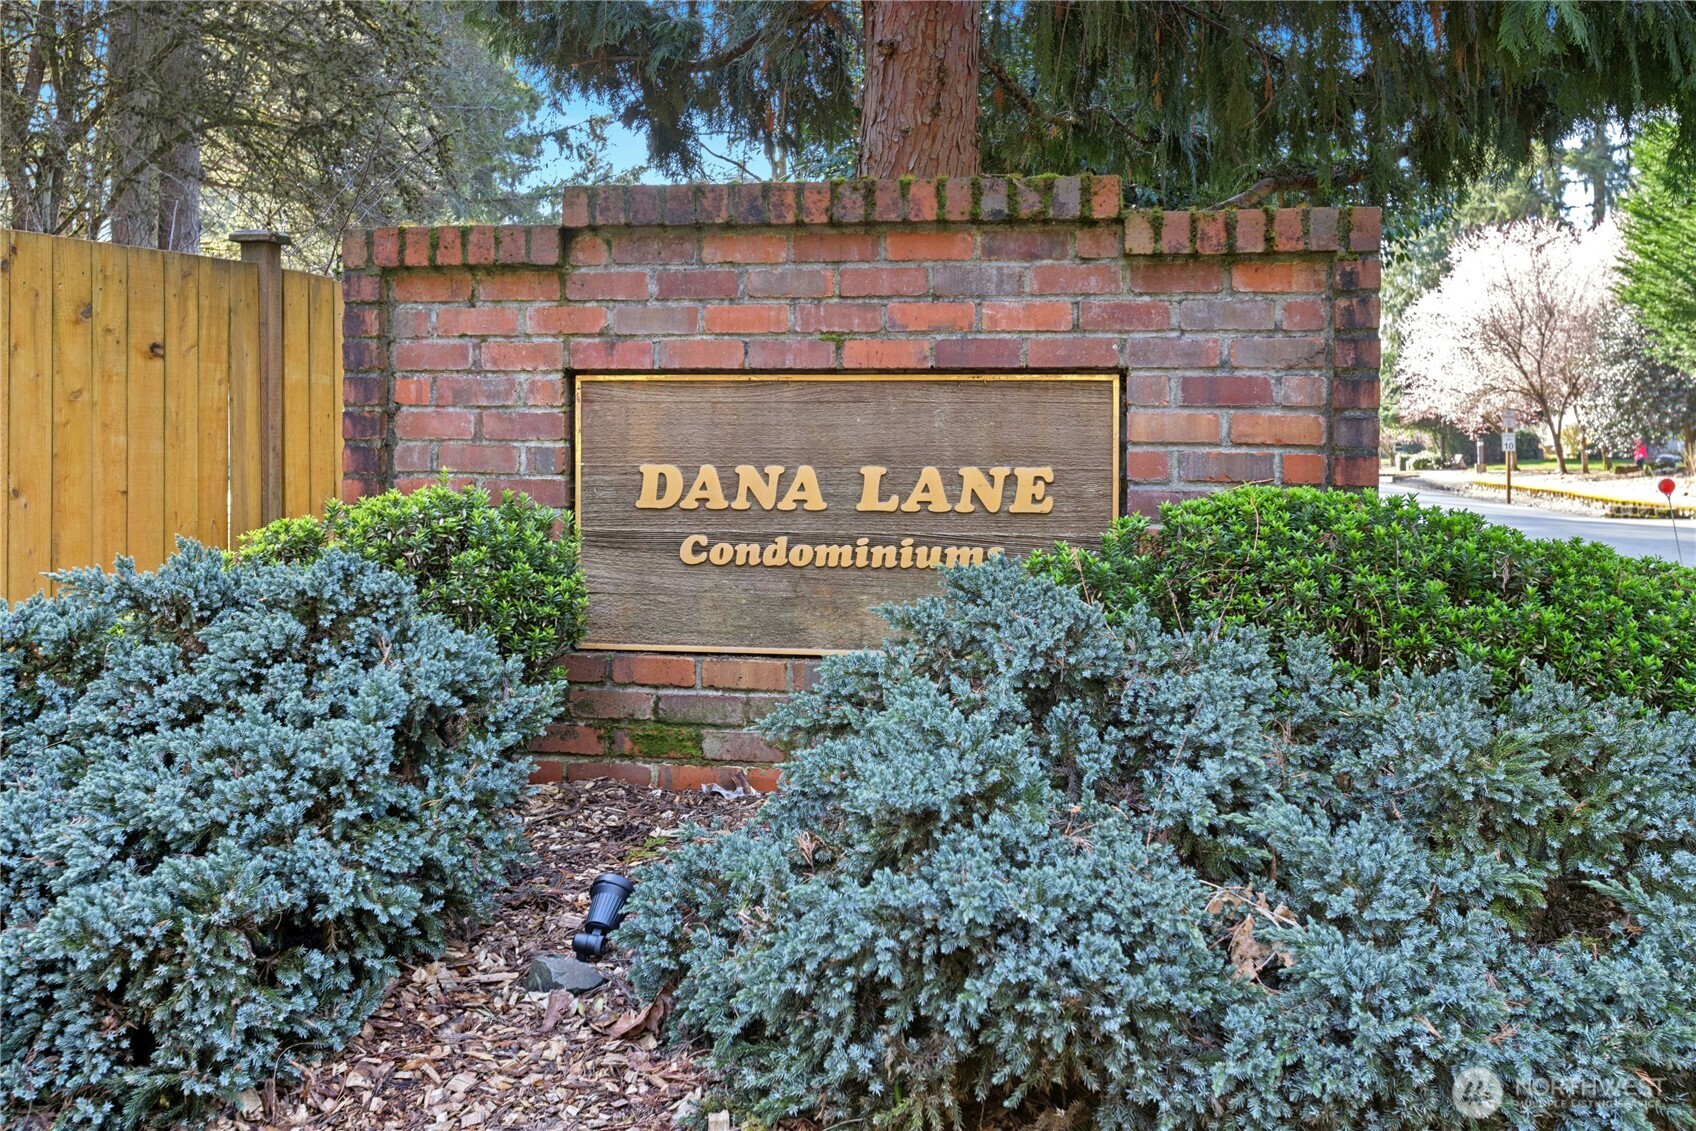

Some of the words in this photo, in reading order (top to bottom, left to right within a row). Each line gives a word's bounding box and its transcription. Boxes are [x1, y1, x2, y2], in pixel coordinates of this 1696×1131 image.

[1504, 442, 1514, 450] 10
[635, 463, 828, 512] DANA
[855, 465, 1055, 514] LANE
